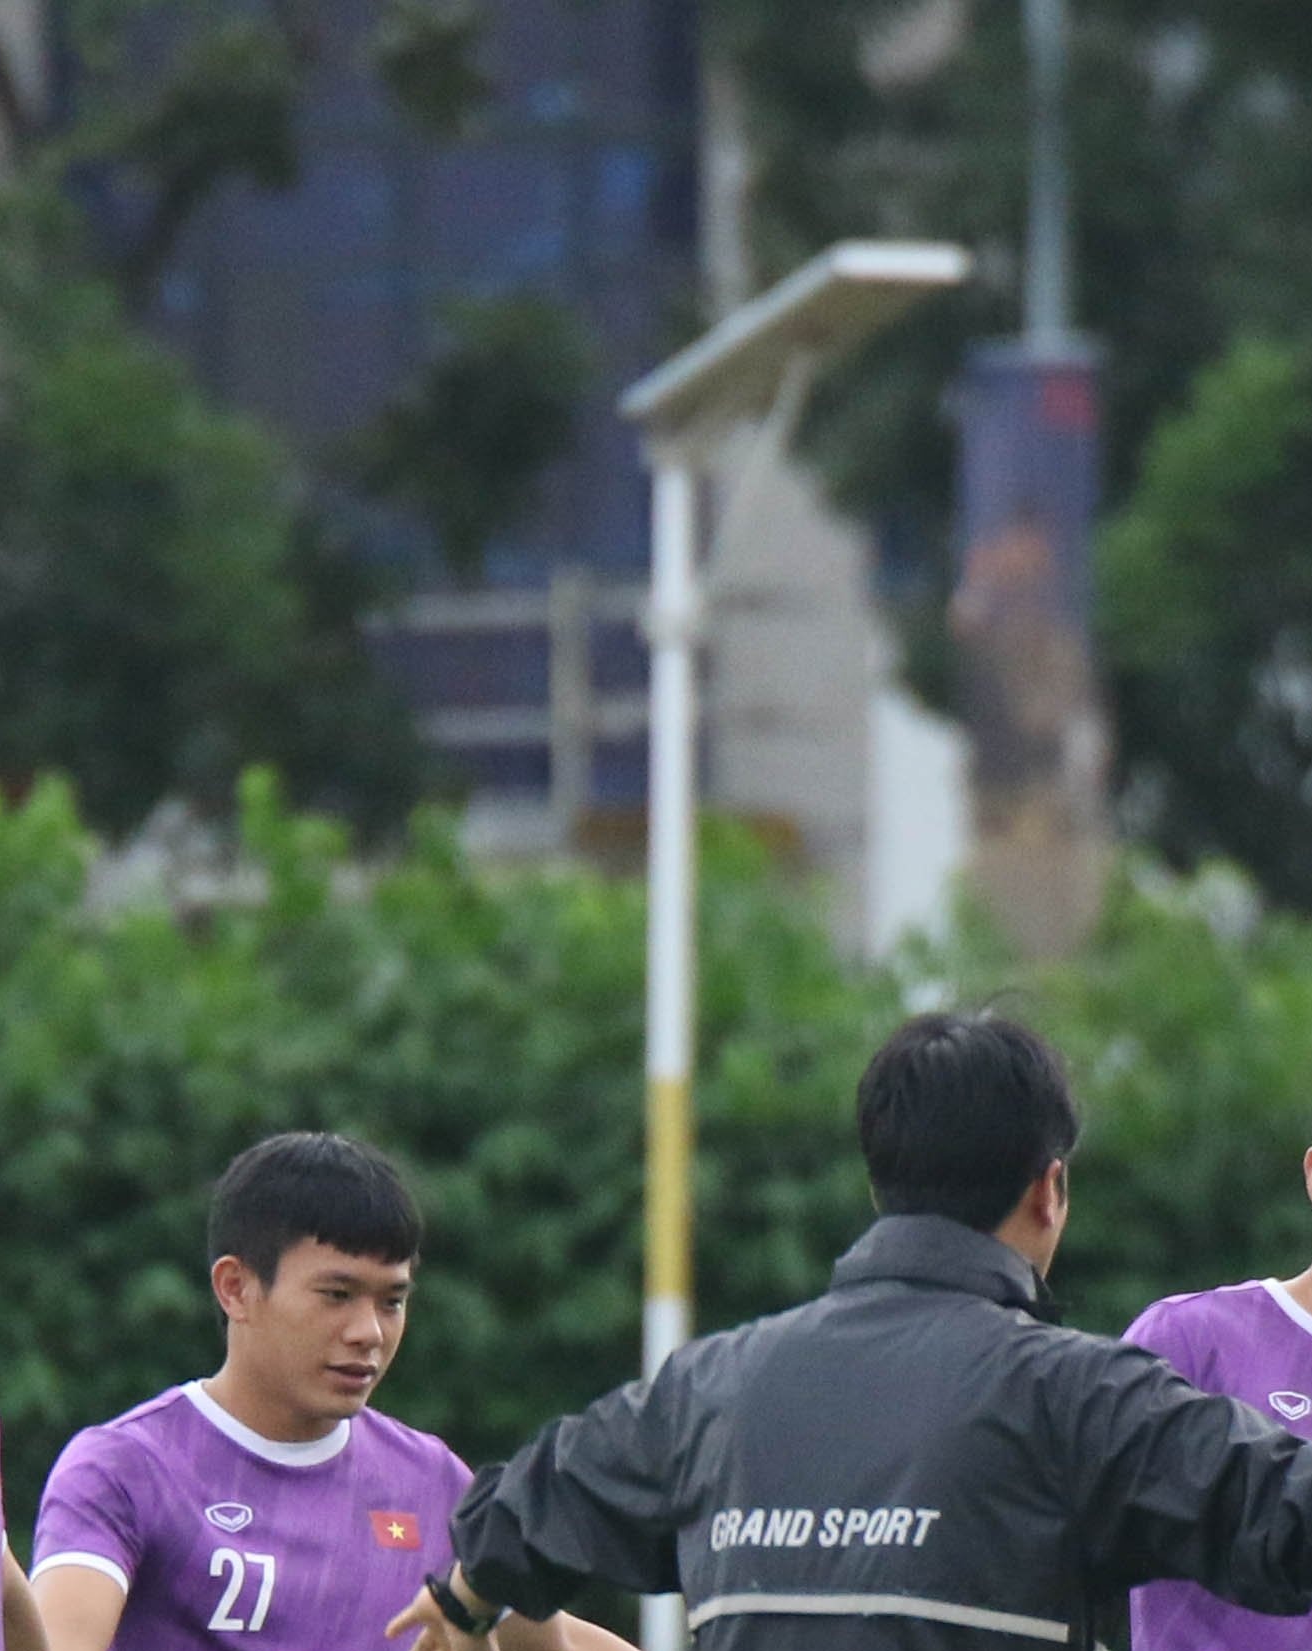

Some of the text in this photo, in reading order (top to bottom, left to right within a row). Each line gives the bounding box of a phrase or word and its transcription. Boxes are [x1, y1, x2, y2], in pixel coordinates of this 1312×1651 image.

[710, 1507, 941, 1551] GRAND SPORT
[207, 1547, 275, 1632] 27
